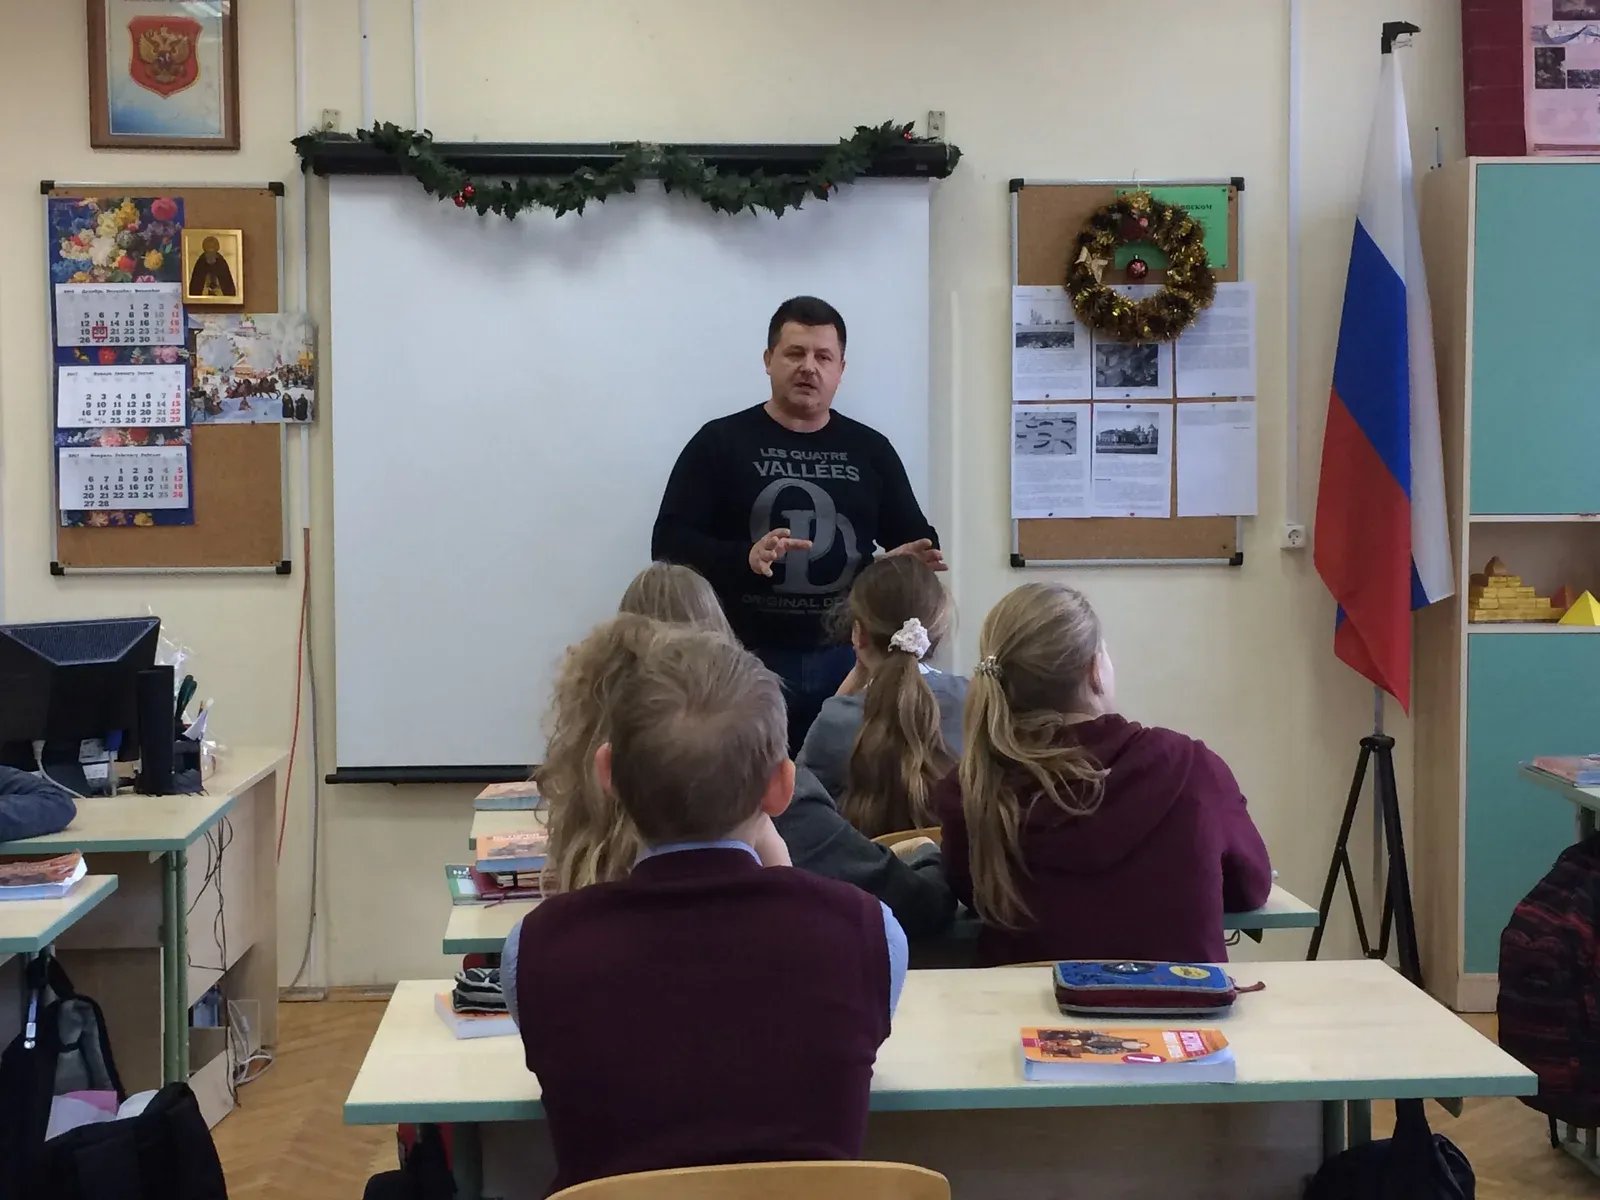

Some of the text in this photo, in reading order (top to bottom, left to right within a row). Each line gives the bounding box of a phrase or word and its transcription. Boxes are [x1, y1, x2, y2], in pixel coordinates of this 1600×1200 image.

[760, 448, 848, 462] LES QUATRE
[752, 461, 860, 482] VALLÉES
